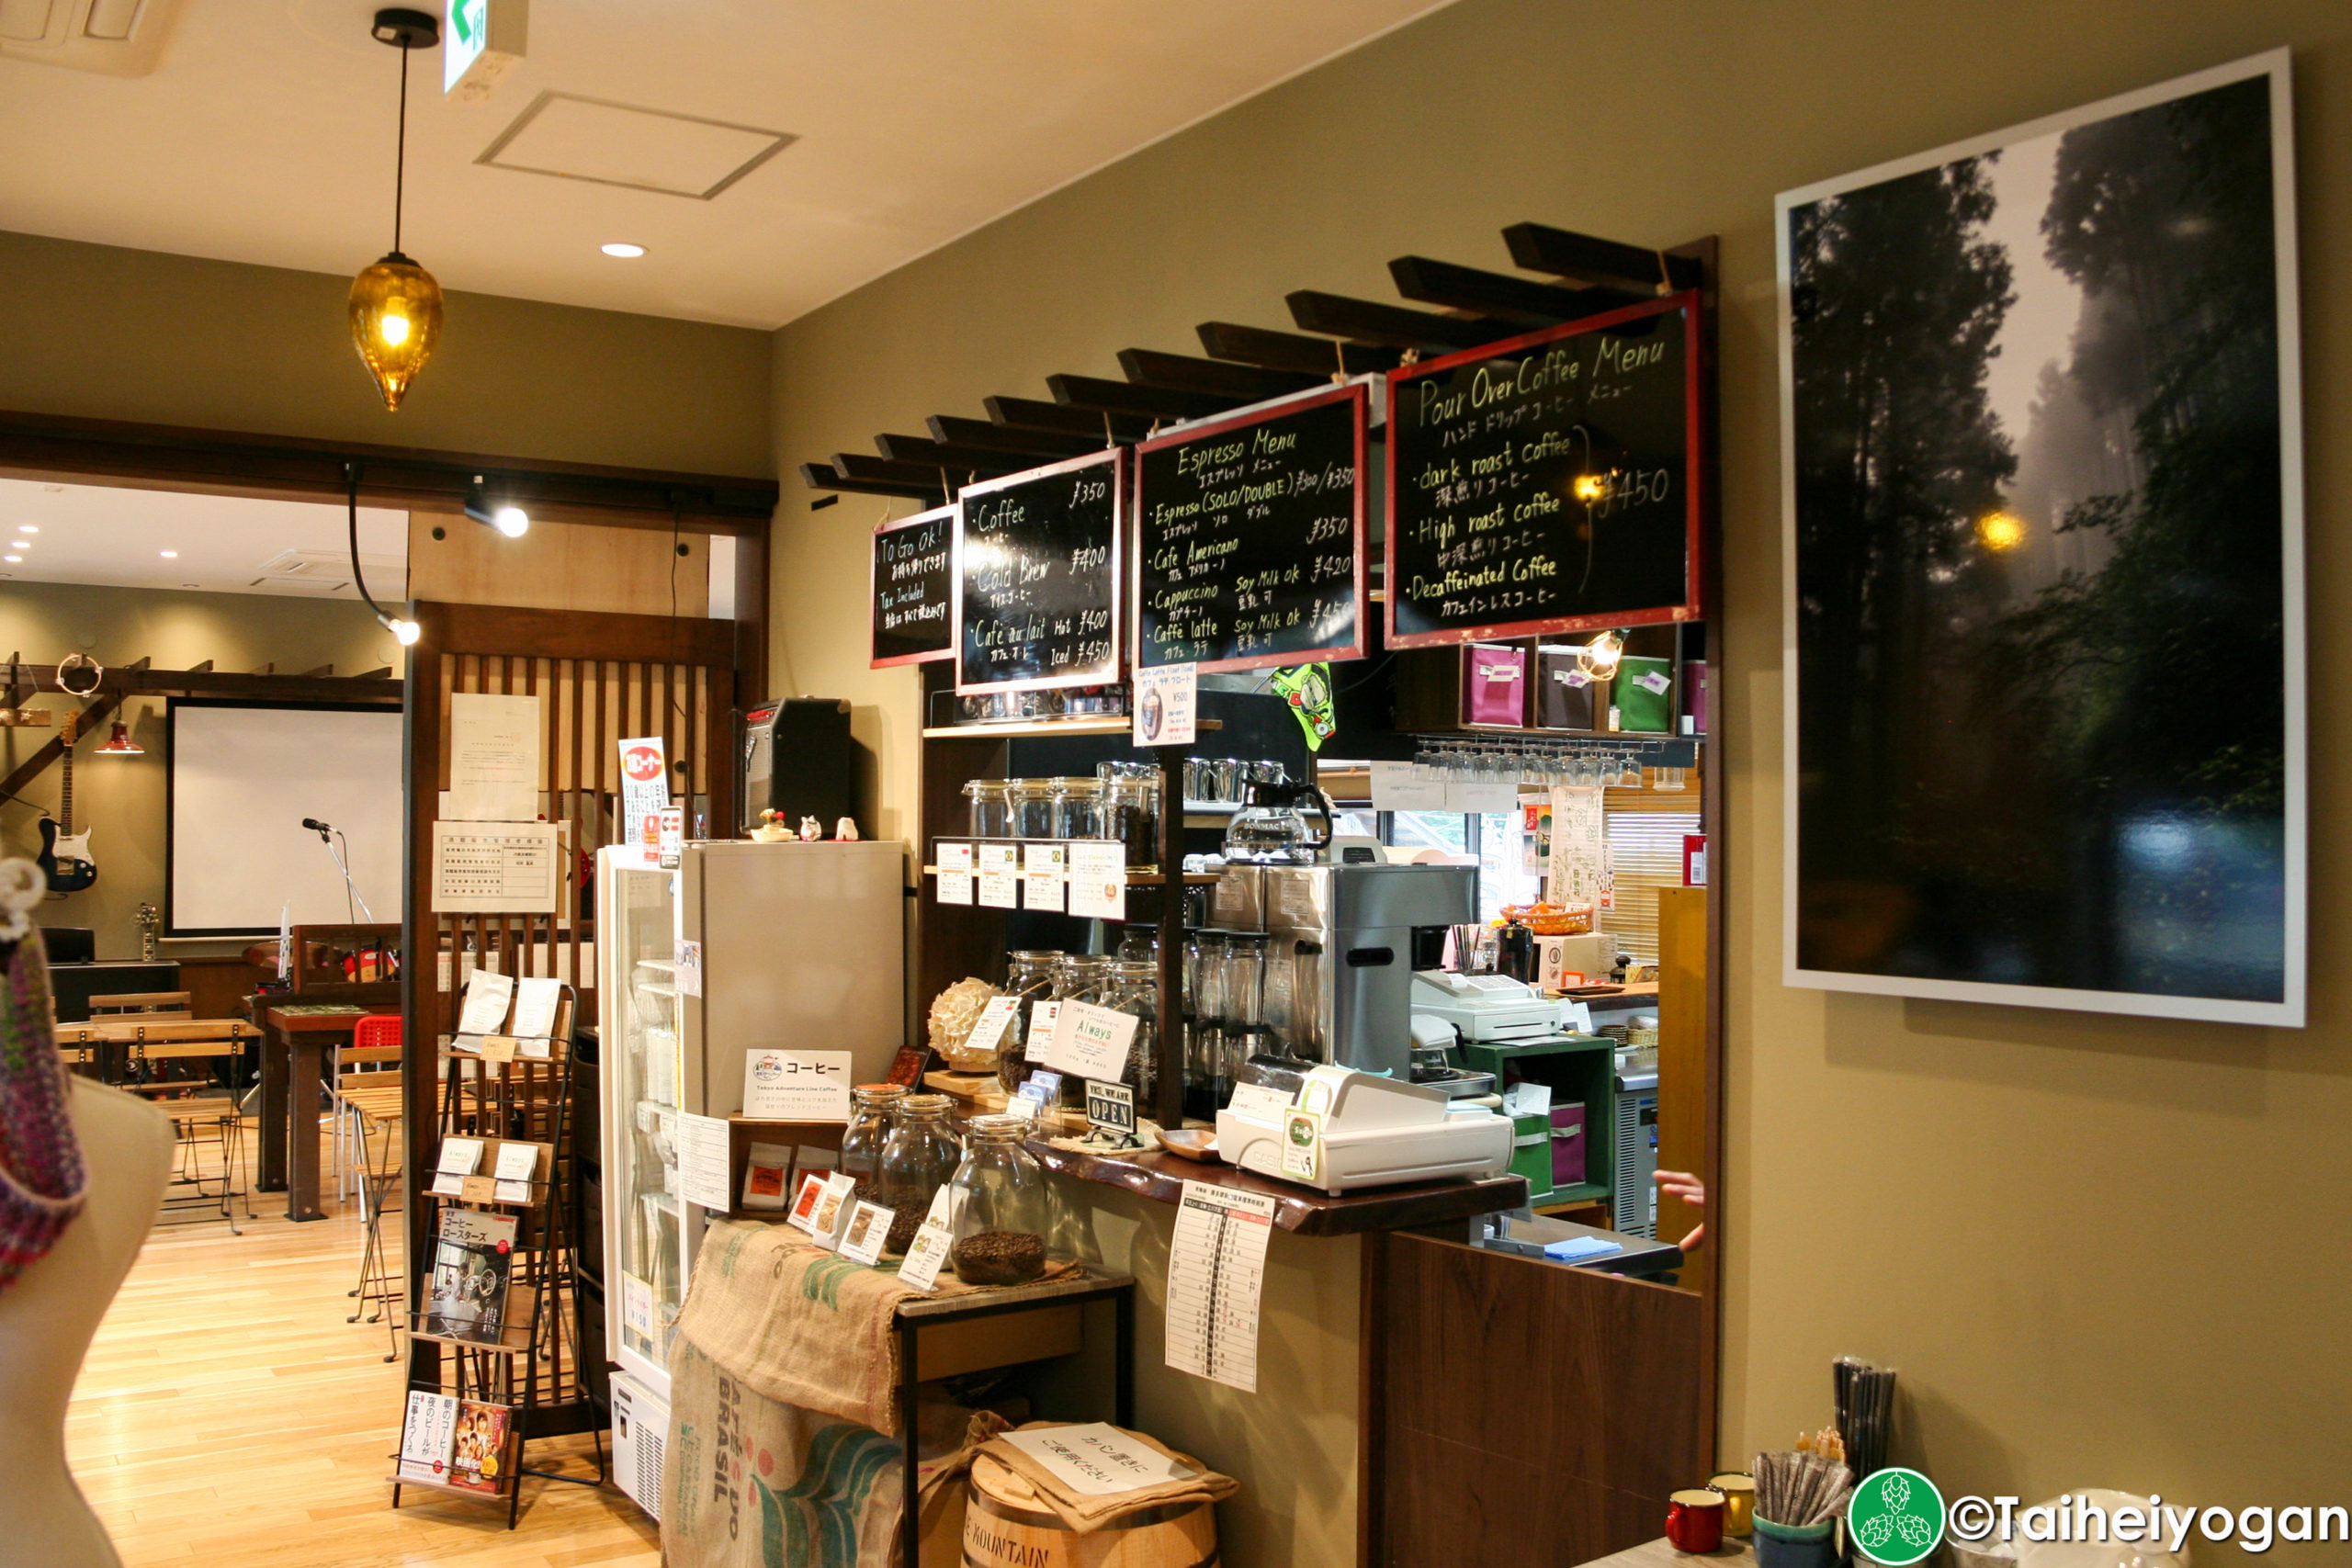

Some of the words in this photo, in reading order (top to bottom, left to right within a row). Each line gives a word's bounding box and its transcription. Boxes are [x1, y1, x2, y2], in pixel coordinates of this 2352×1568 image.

[1420, 380, 1465, 427] Pour
[1471, 368, 1513, 408] Over
[1518, 349, 1578, 394] Coffee
[1592, 337, 1665, 378] Menu
[1178, 443, 1243, 477] Espresso
[1252, 428, 1296, 455] Menu
[1253, 458, 1281, 473] メニュー
[1420, 458, 1460, 489] dark
[1472, 442, 1512, 475] roast
[978, 499, 1025, 532] Coffee
[1069, 481, 1105, 508] ¥350
[1187, 538, 1238, 565] Americano
[1306, 516, 1348, 544] ¥350
[1419, 515, 1455, 549] High
[1469, 502, 1505, 533] roast
[898, 535, 913, 558] Go
[978, 558, 1011, 592] Cold
[1020, 555, 1050, 585] Brew
[1069, 547, 1105, 574] ¥400
[1155, 581, 1217, 609] Cappuccino
[1235, 577, 1254, 593] Soy
[1258, 570, 1279, 587] Milk
[1310, 555, 1351, 583] ¥420
[1413, 560, 1505, 601] Decaffeinated
[880, 592, 893, 610] Tax
[898, 581, 924, 604] Included
[1442, 588, 1555, 616] カフェインレスコーヒー
[1026, 614, 1045, 640] lait
[1055, 618, 1070, 635] Hot
[1079, 610, 1107, 635] ¥400
[1192, 617, 1217, 638] latte
[1234, 622, 1253, 639] Soy
[1258, 613, 1281, 629] Milk
[1051, 645, 1069, 666] Iced
[1075, 641, 1109, 666] ¥450
[1077, 1020, 1112, 1040] Always
[786, 1063, 840, 1074] コーヒー
[1092, 1100, 1127, 1124] OPEN
[443, 1229, 488, 1242] ロースターズ
[445, 1218, 473, 1228] コーヒー
[714, 1377, 730, 1503] BRASIL
[1080, 1437, 1148, 1472] カバン置きに
[1042, 1439, 1113, 1483] ご使用ください
[973, 1523, 1048, 1568] MOUNTAIN
